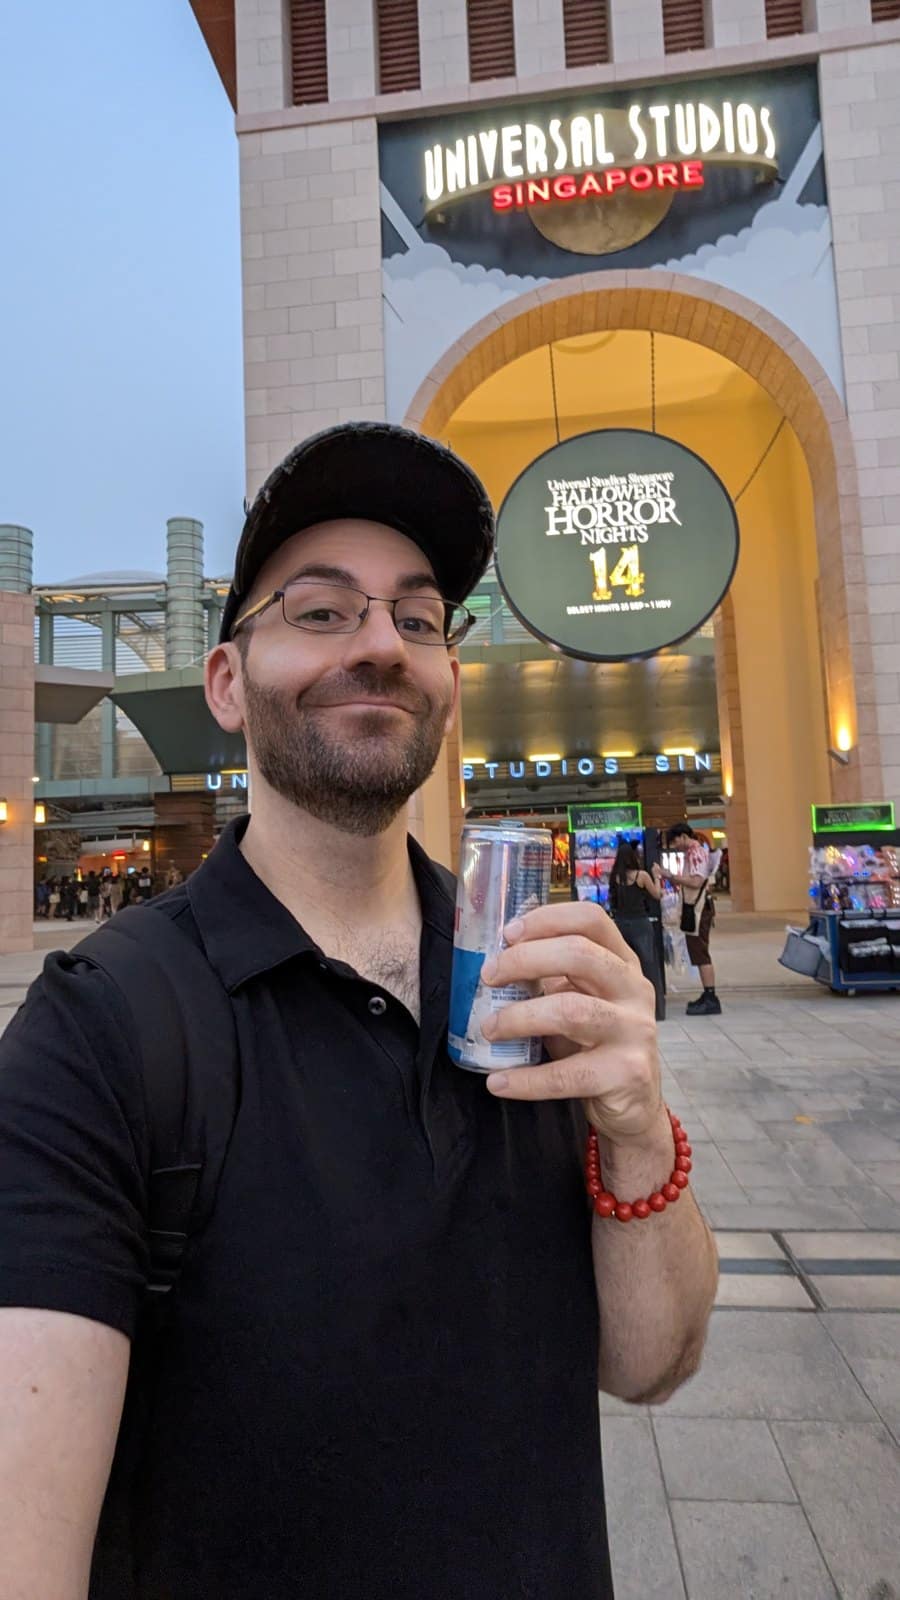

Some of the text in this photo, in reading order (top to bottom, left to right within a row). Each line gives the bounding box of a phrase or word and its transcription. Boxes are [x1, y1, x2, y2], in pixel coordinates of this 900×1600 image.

[424, 102, 776, 200] UNIVERSAL STUDIOS
[492, 160, 705, 212] SINGAPORE
[552, 481, 672, 507] HALLOWEEN
[544, 497, 683, 536] HORROR
[580, 524, 649, 545] NIGHTS
[589, 544, 645, 601] 14
[463, 757, 618, 780] STUDIOS
